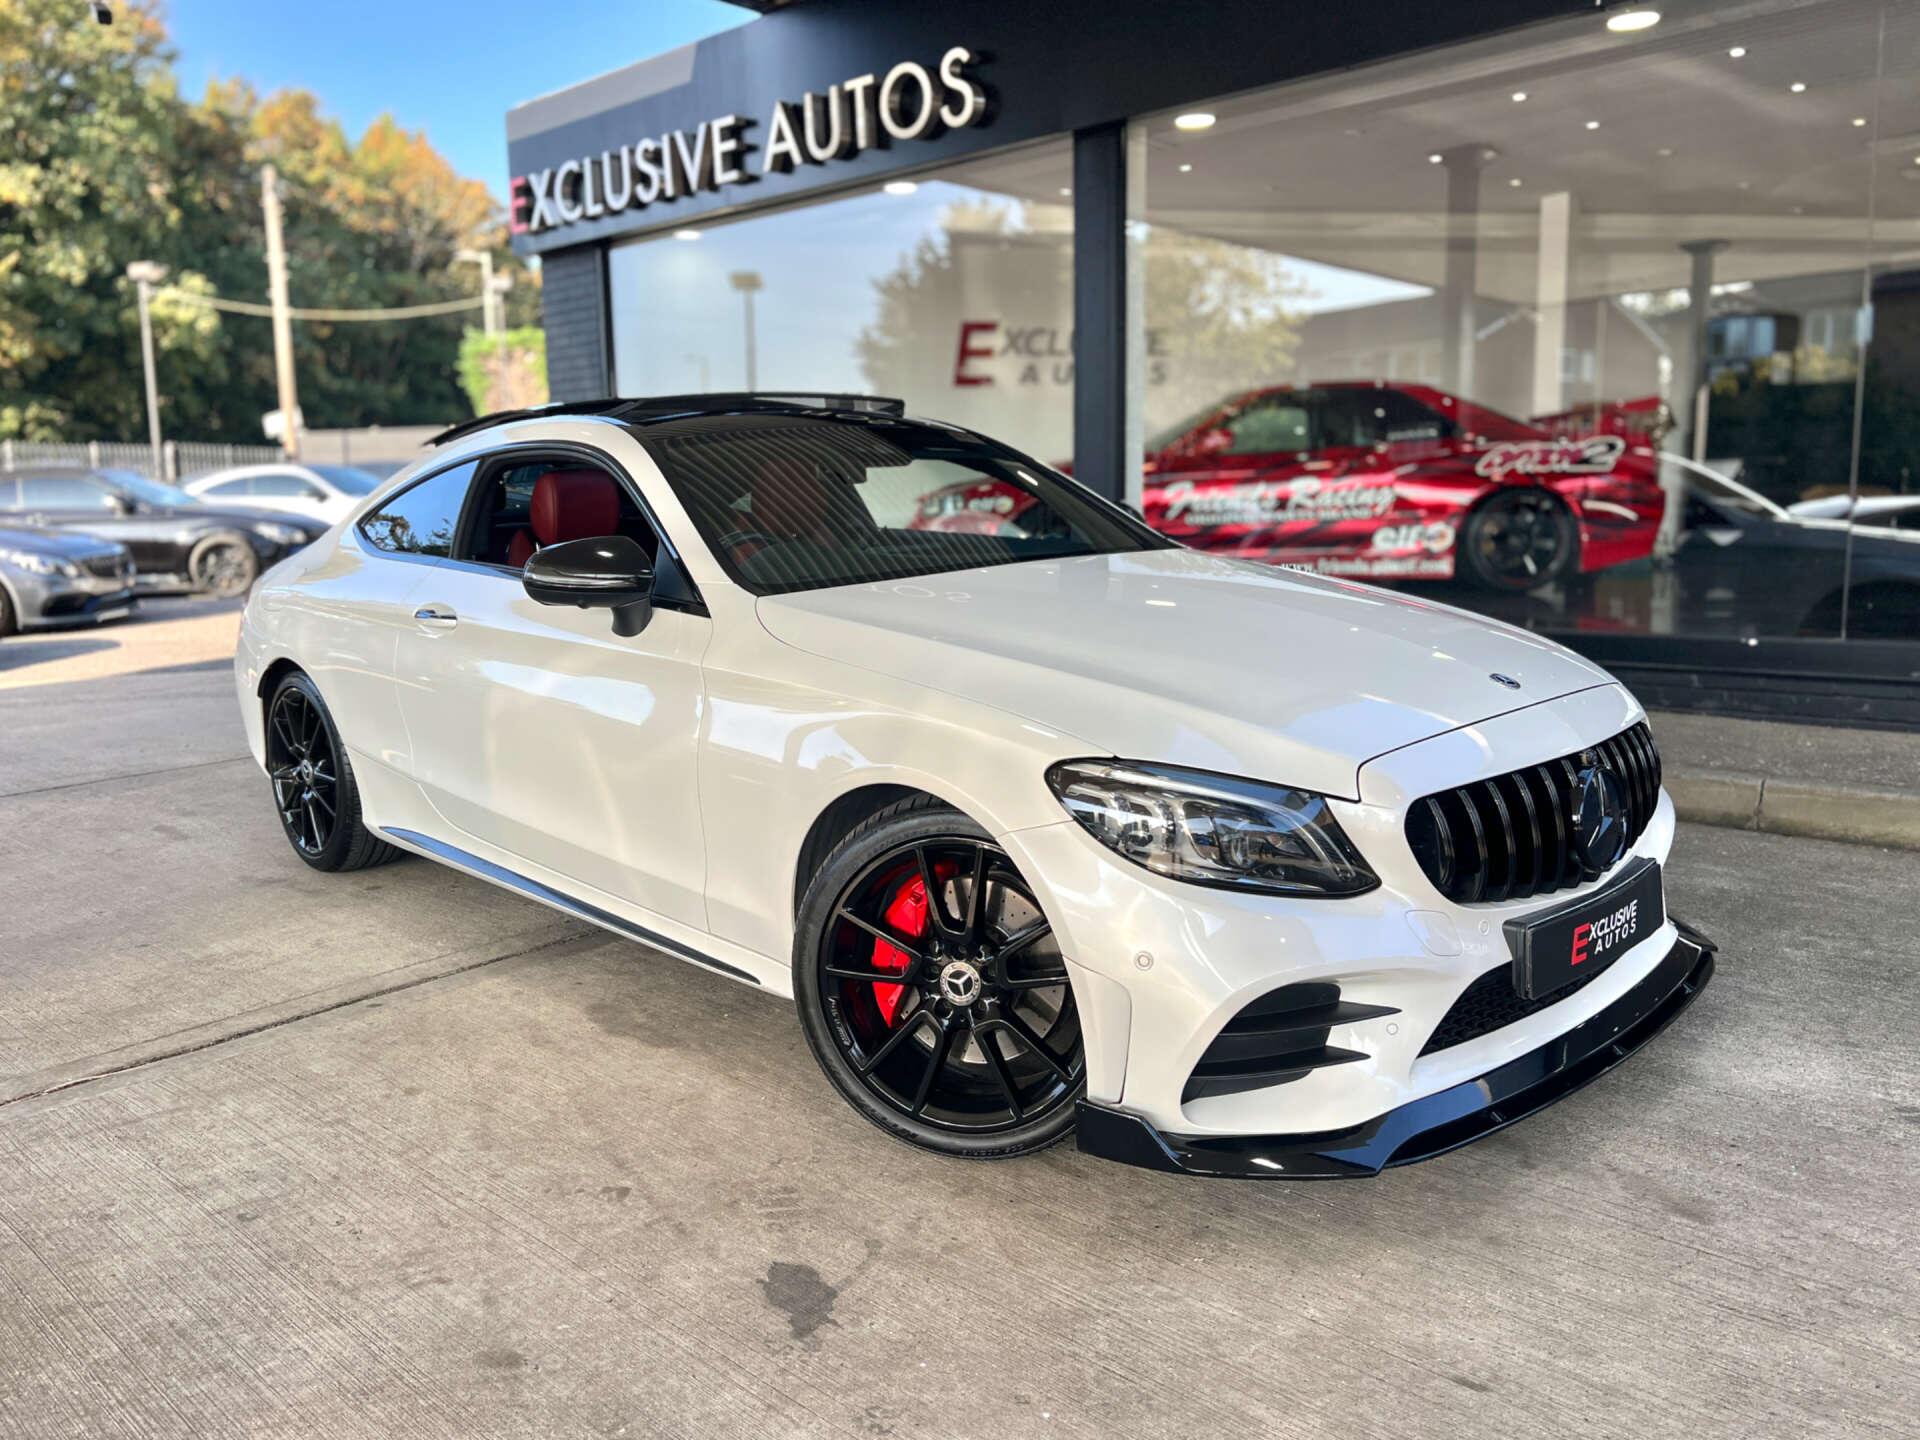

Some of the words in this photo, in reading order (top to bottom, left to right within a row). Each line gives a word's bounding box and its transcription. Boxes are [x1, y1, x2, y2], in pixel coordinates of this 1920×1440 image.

[509, 114, 745, 234] EXCLUSIVE
[763, 46, 980, 173] AUTOS
[954, 321, 1168, 387] EXCLE
[1018, 363, 1167, 386] AUS
[1570, 899, 1638, 966] EXCLUSIVE
[1594, 918, 1637, 955] AUTOS
